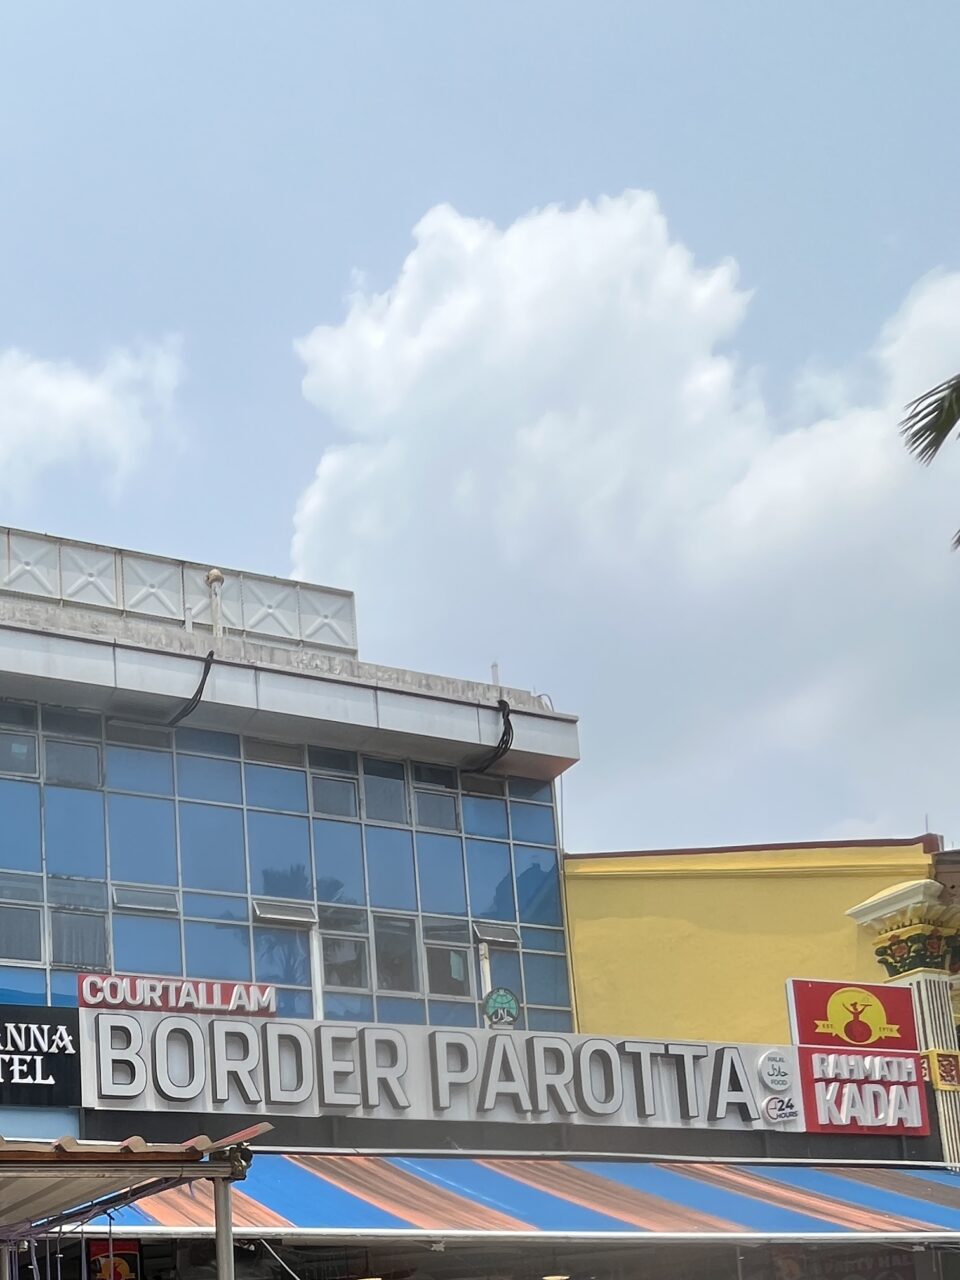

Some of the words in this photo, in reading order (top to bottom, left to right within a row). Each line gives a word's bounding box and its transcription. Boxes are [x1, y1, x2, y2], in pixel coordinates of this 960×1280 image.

[82, 975, 277, 1013] COURTALLAM
[95, 1013, 411, 1109] BORDER
[428, 1030, 761, 1121] PAROTTA
[812, 1053, 917, 1082] RAHMATH
[777, 1098, 795, 1112] 24
[777, 1111, 798, 1119] HOURS
[814, 1081, 923, 1128] KADAI
